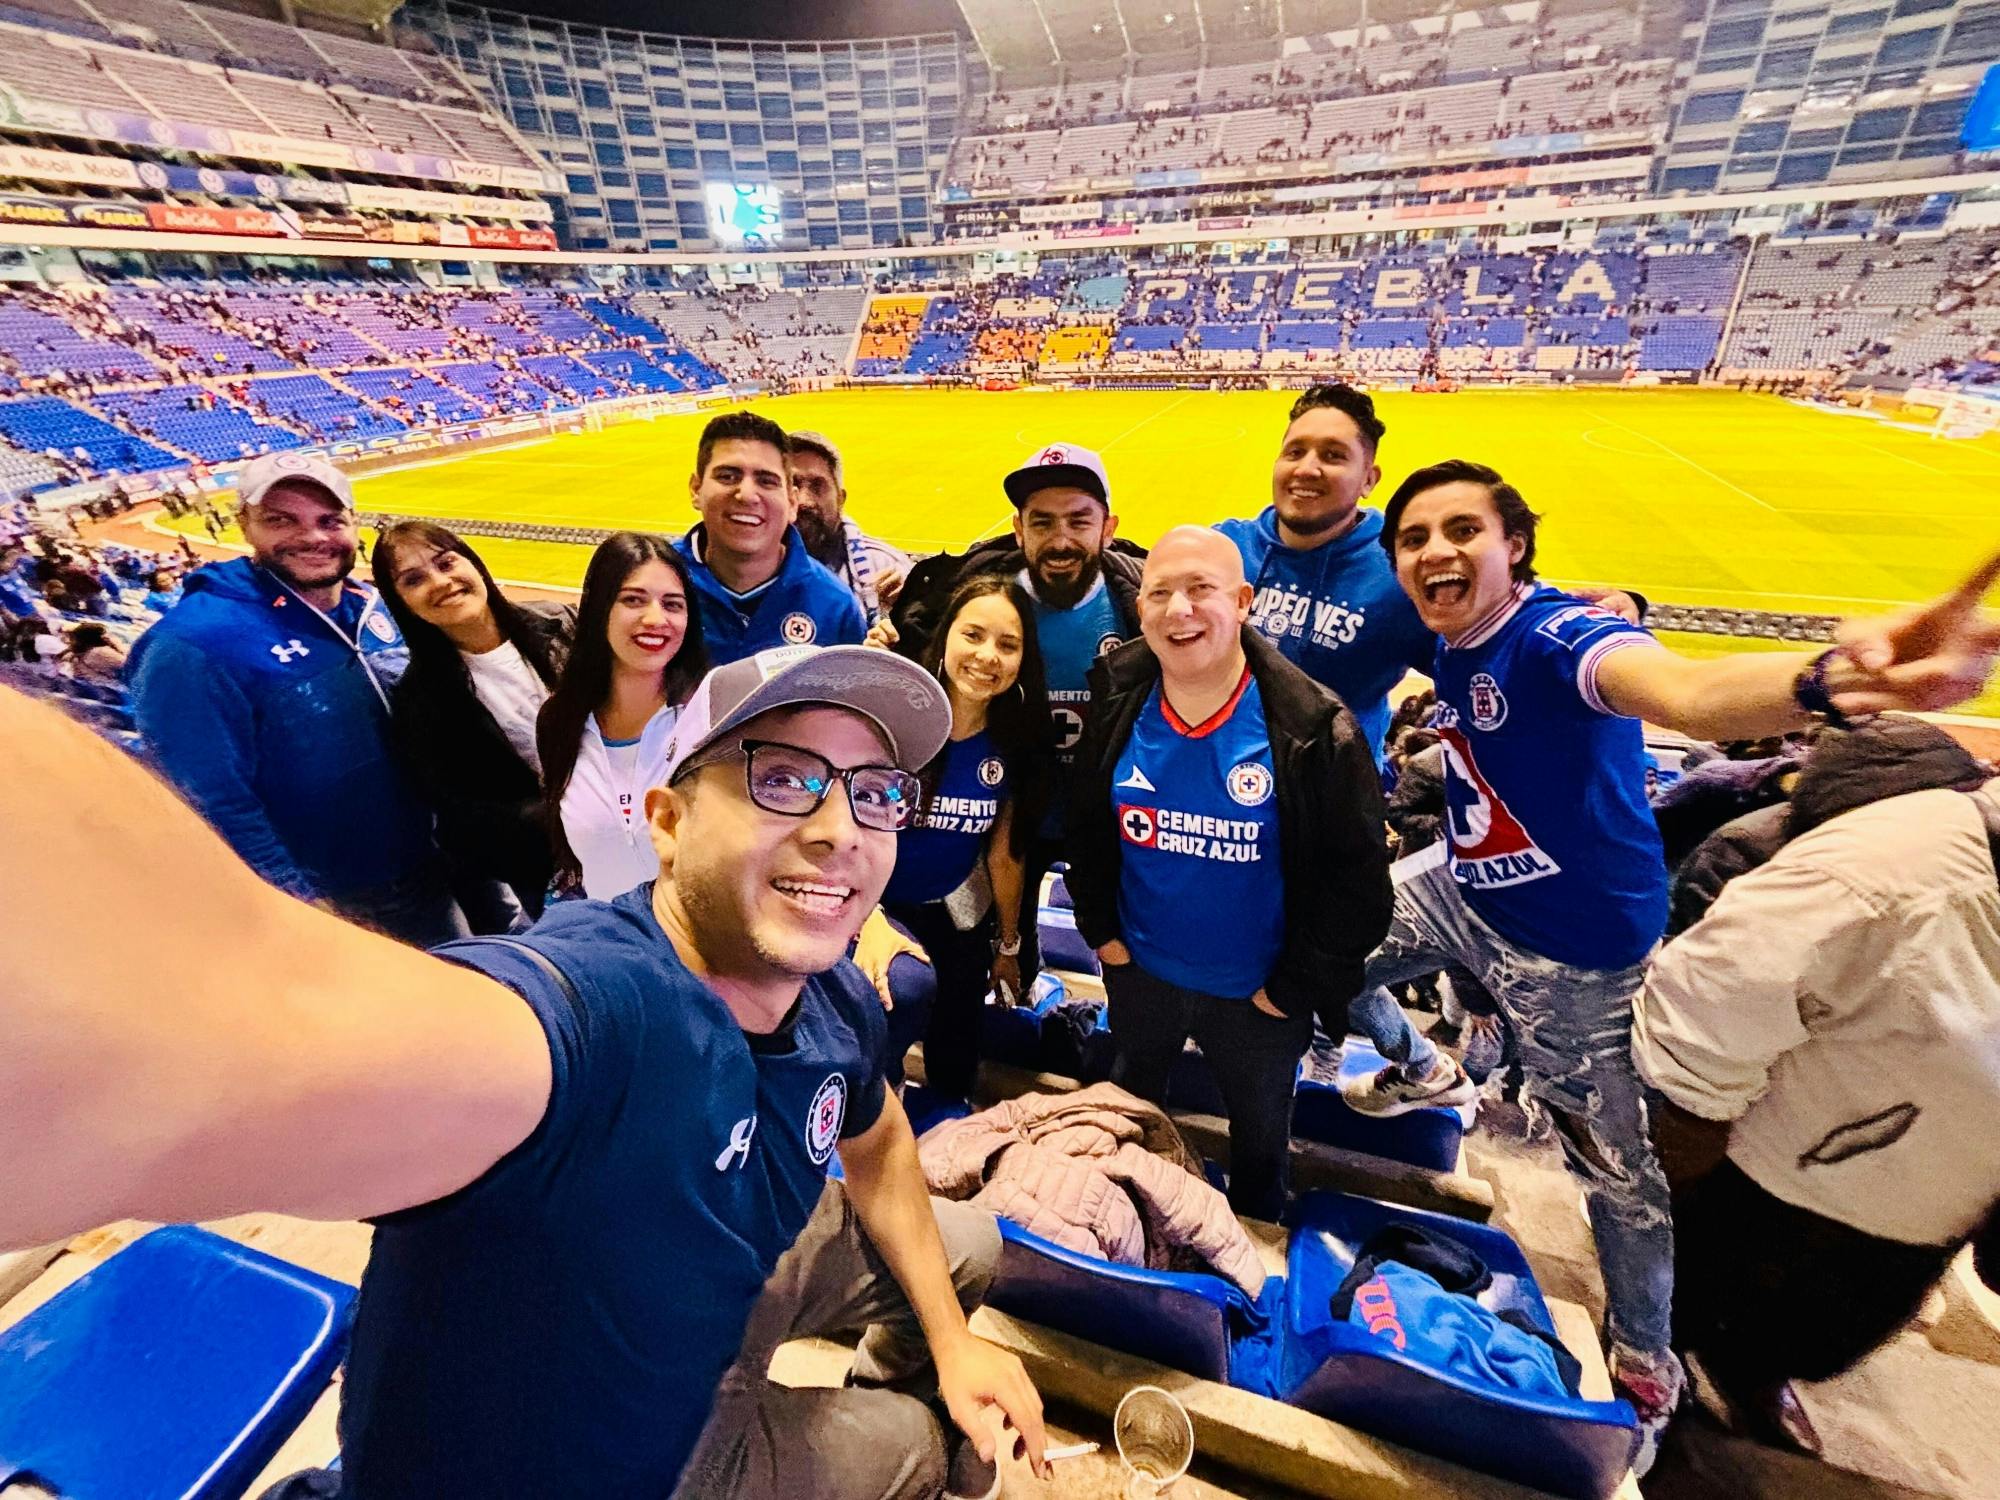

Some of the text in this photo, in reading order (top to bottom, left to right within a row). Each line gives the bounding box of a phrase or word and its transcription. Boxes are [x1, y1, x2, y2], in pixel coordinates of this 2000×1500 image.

[1199, 194, 1243, 206] PIRMA
[955, 211, 994, 223] PIRMA
[1136, 259, 1617, 317] PUEBLA
[1047, 689, 1092, 702] MENTO
[930, 795, 998, 817] EMENTO
[1156, 808, 1260, 842] CEMENTO
[1156, 832, 1262, 863] CRUZ AZUL
[1482, 851, 1551, 884] AZUL
